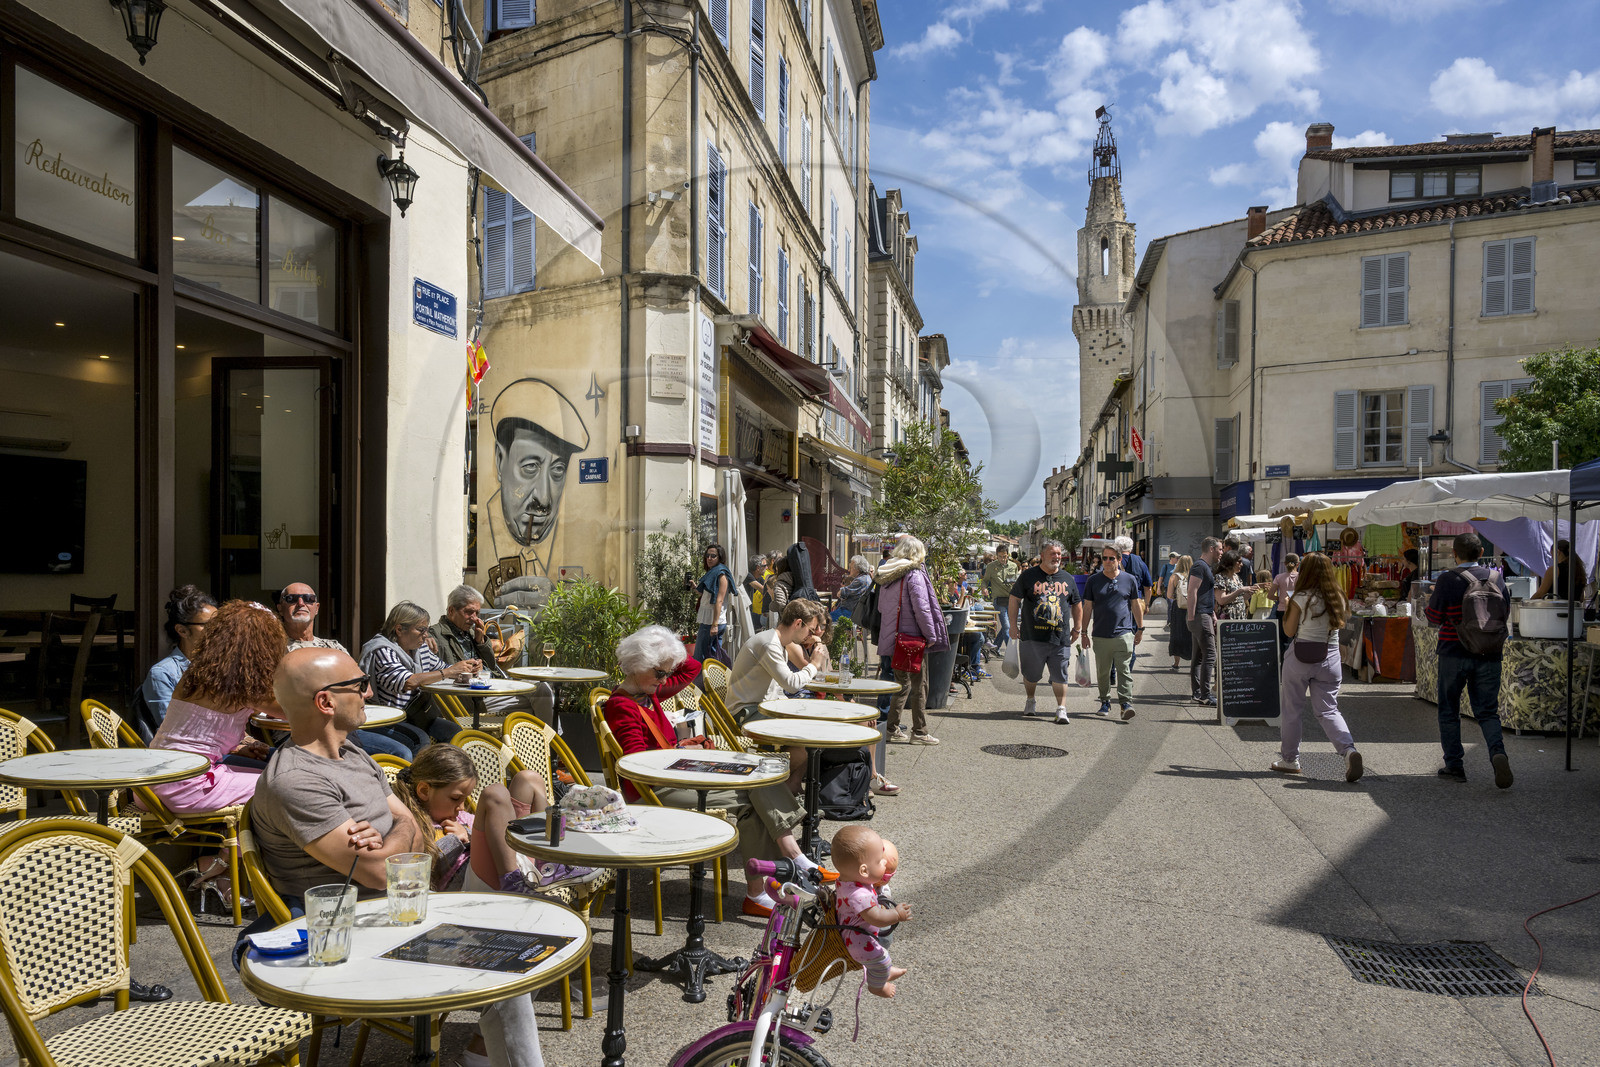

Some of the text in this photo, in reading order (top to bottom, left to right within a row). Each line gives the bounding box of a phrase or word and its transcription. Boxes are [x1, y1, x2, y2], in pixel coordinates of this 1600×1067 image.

[24, 138, 134, 207] Restauration
[200, 212, 233, 249] Bar
[422, 286, 431, 297] RUE
[436, 293, 449, 305] PLACE
[415, 302, 456, 327] PORTAIL MATHERON
